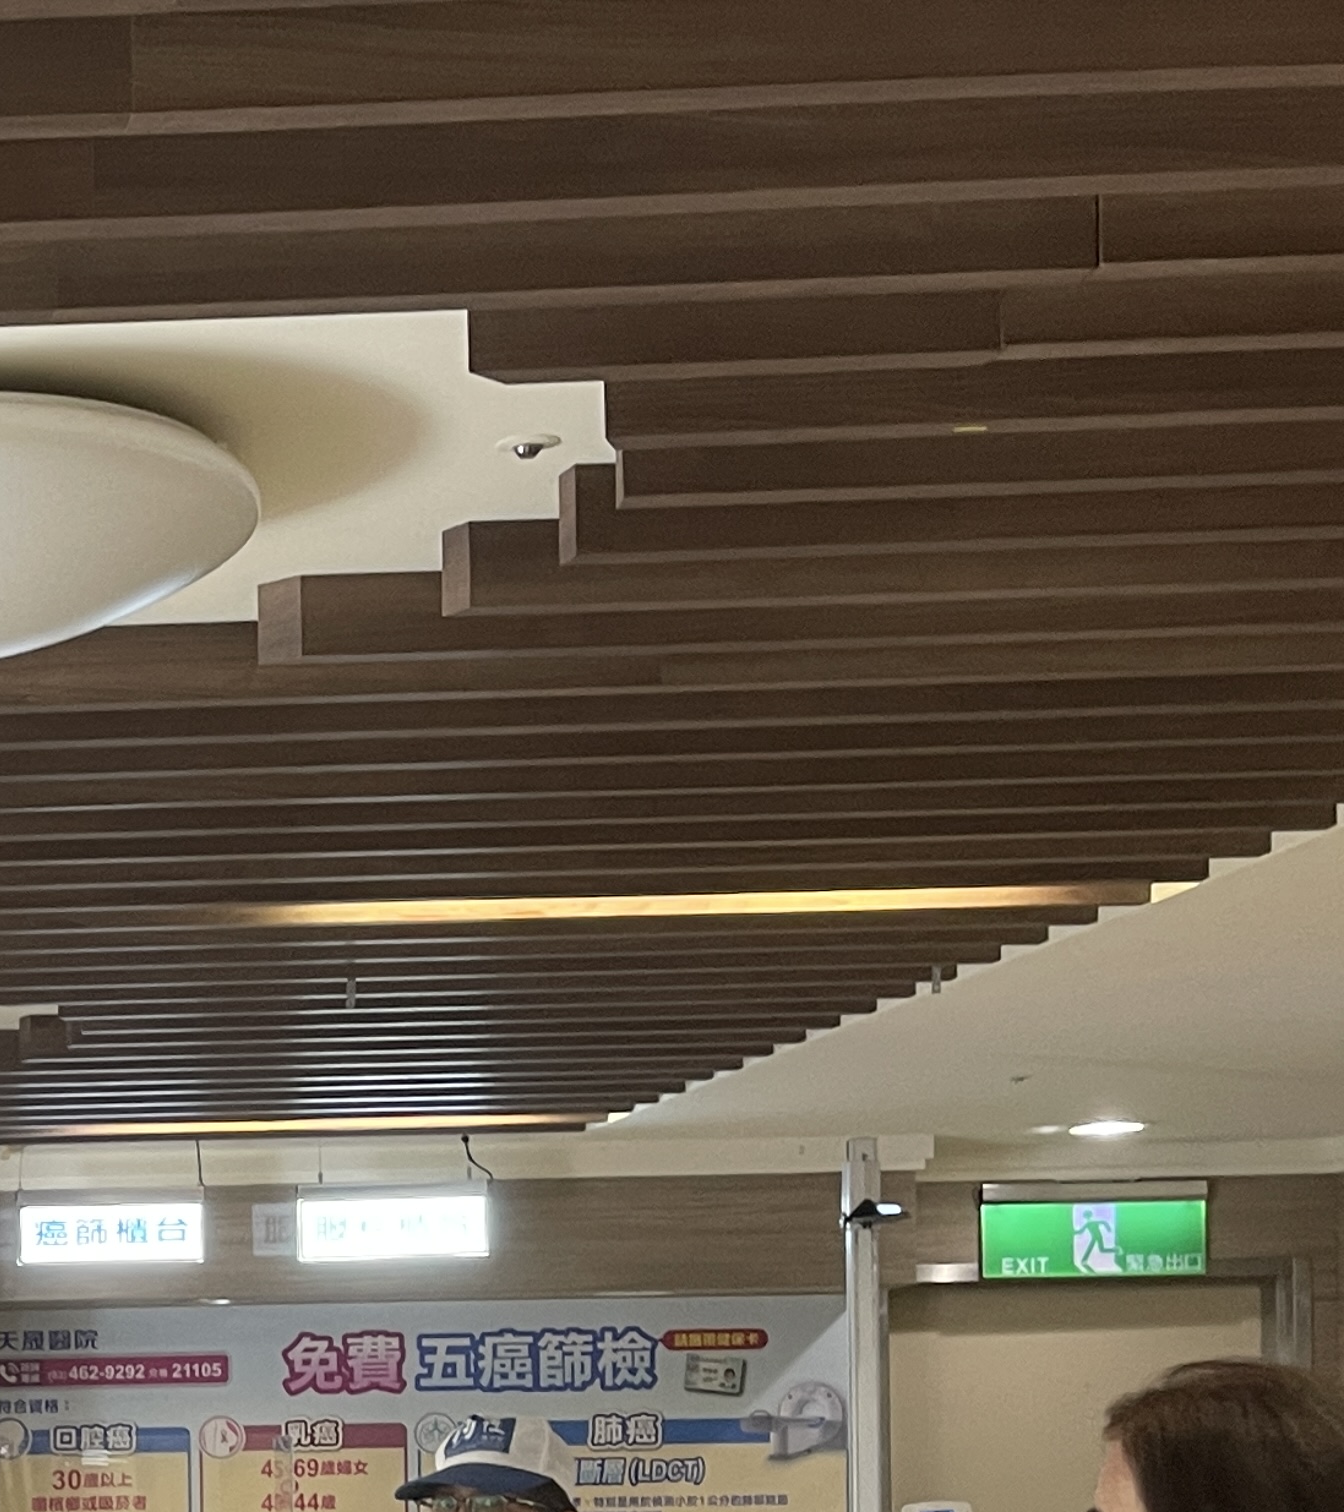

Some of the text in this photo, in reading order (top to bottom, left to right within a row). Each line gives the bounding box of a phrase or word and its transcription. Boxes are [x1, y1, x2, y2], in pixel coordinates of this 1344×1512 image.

[34, 1217, 189, 1246] 癌篩櫃台
[1001, 1256, 1050, 1274] EXIT
[1125, 1253, 1203, 1272] 緊急出口
[68, 1363, 146, 1381] 462-9292
[171, 1362, 223, 1379] 21105
[281, 1325, 660, 1396] 免費 五癌篩檢
[53, 1423, 135, 1452] 口腔癌
[285, 1418, 340, 1447] 乳癌
[591, 1412, 662, 1448] 肺癌
[52, 1468, 134, 1491] 30歲以上
[260, 1458, 369, 1479] 4569歲婦女
[628, 1455, 707, 1487] (LDCT)
